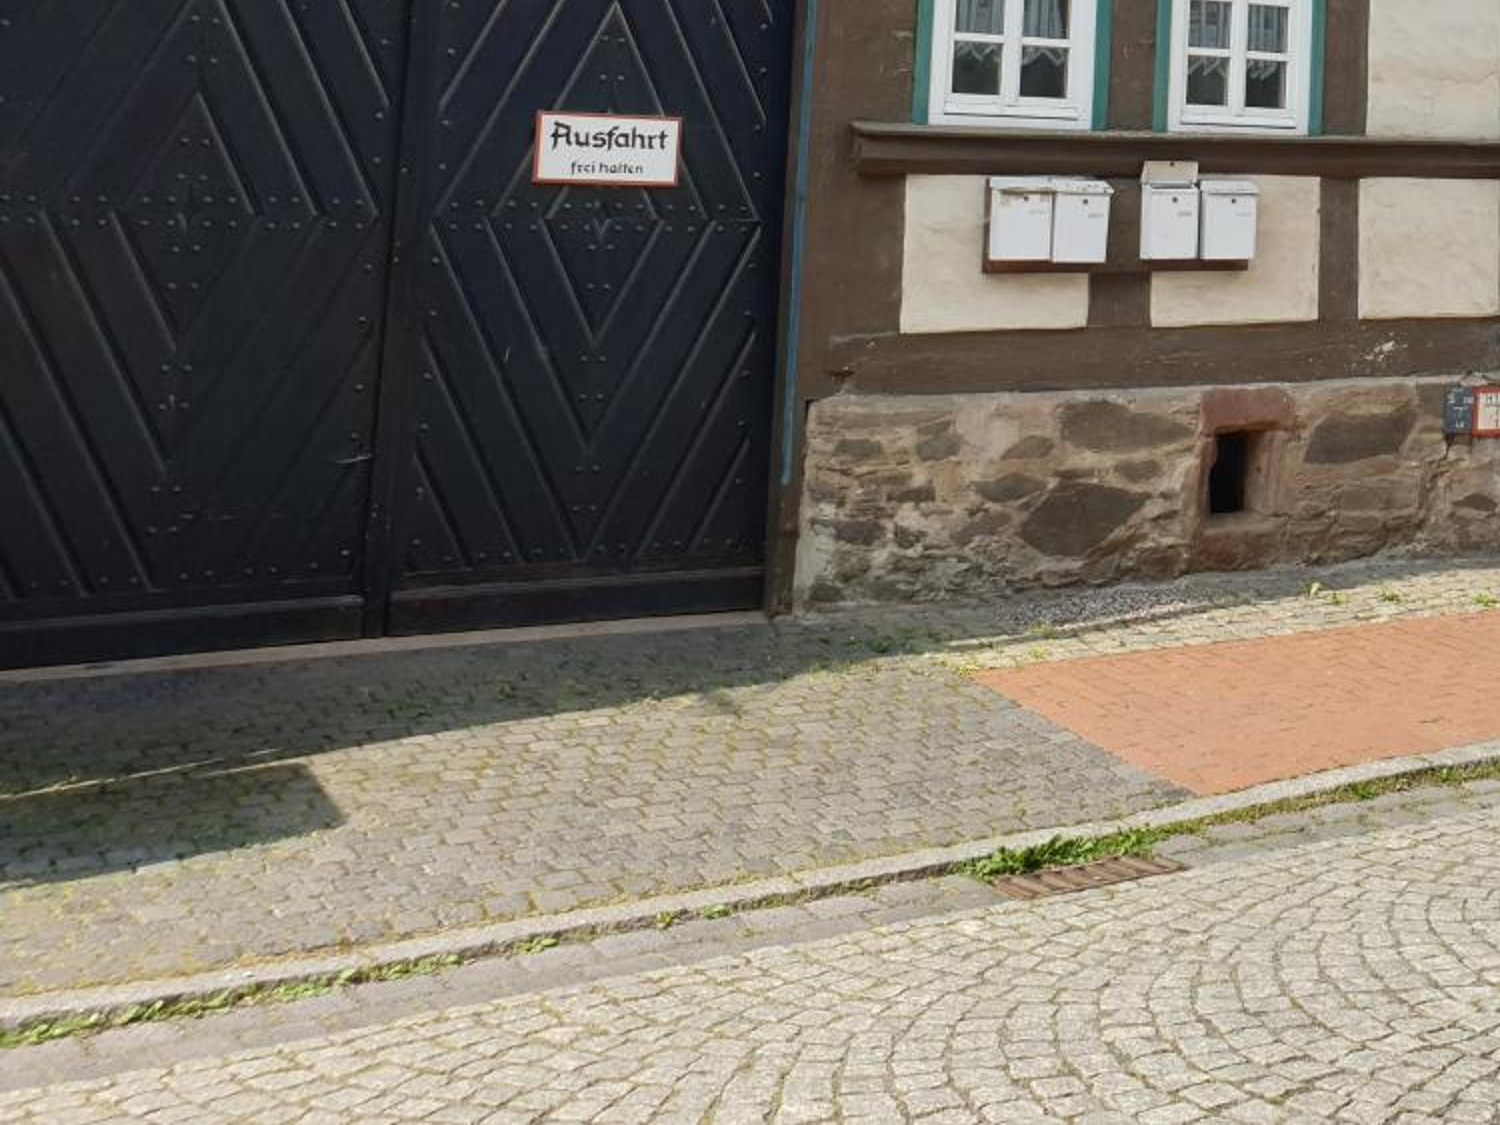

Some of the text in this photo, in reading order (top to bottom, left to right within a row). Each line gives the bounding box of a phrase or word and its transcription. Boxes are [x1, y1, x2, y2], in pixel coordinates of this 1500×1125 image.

[551, 121, 669, 151] Ausfahrt
[571, 161, 644, 175] frei halten
